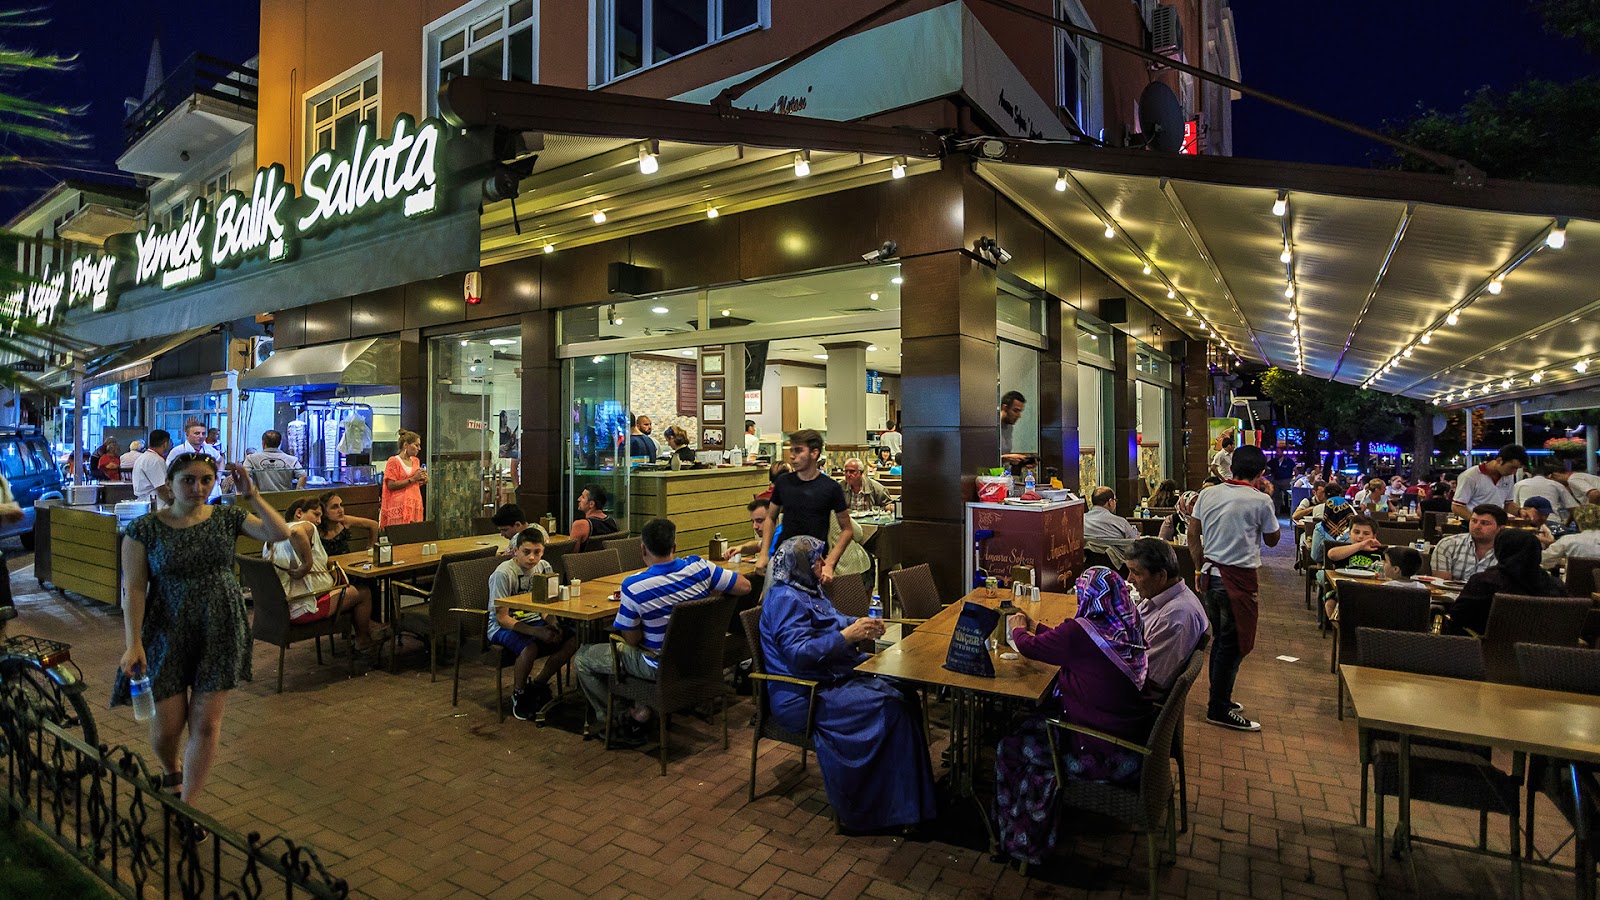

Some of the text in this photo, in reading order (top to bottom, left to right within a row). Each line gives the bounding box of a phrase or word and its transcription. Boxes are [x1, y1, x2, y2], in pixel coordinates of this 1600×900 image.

[68, 253, 116, 307] Döner
[135, 199, 206, 285] Yemek
[211, 168, 285, 264] Balık
[298, 118, 437, 232] Salata
